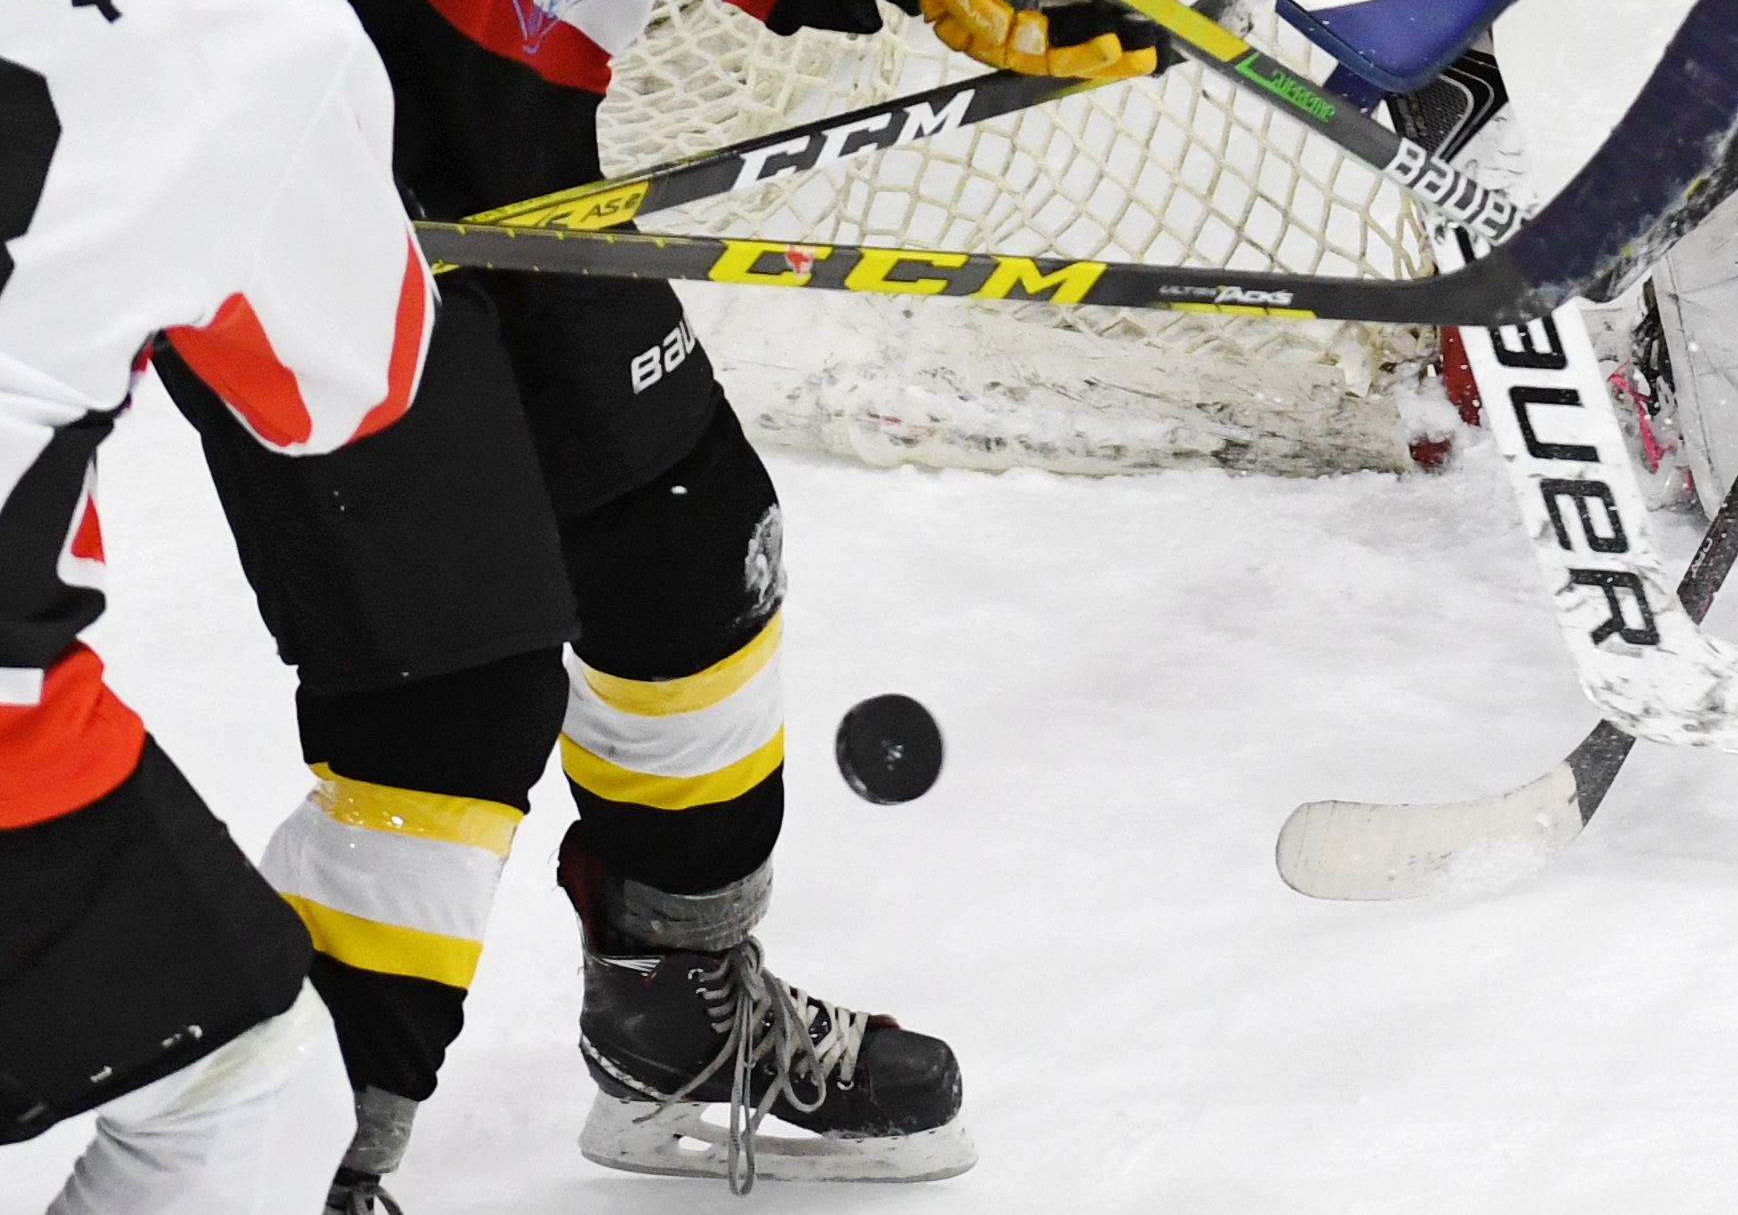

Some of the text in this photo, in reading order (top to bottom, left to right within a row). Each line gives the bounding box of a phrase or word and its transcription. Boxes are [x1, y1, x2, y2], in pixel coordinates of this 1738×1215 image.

[732, 88, 976, 191] CCM
[708, 239, 1107, 305] CCM
[1488, 314, 1661, 648] AUER
